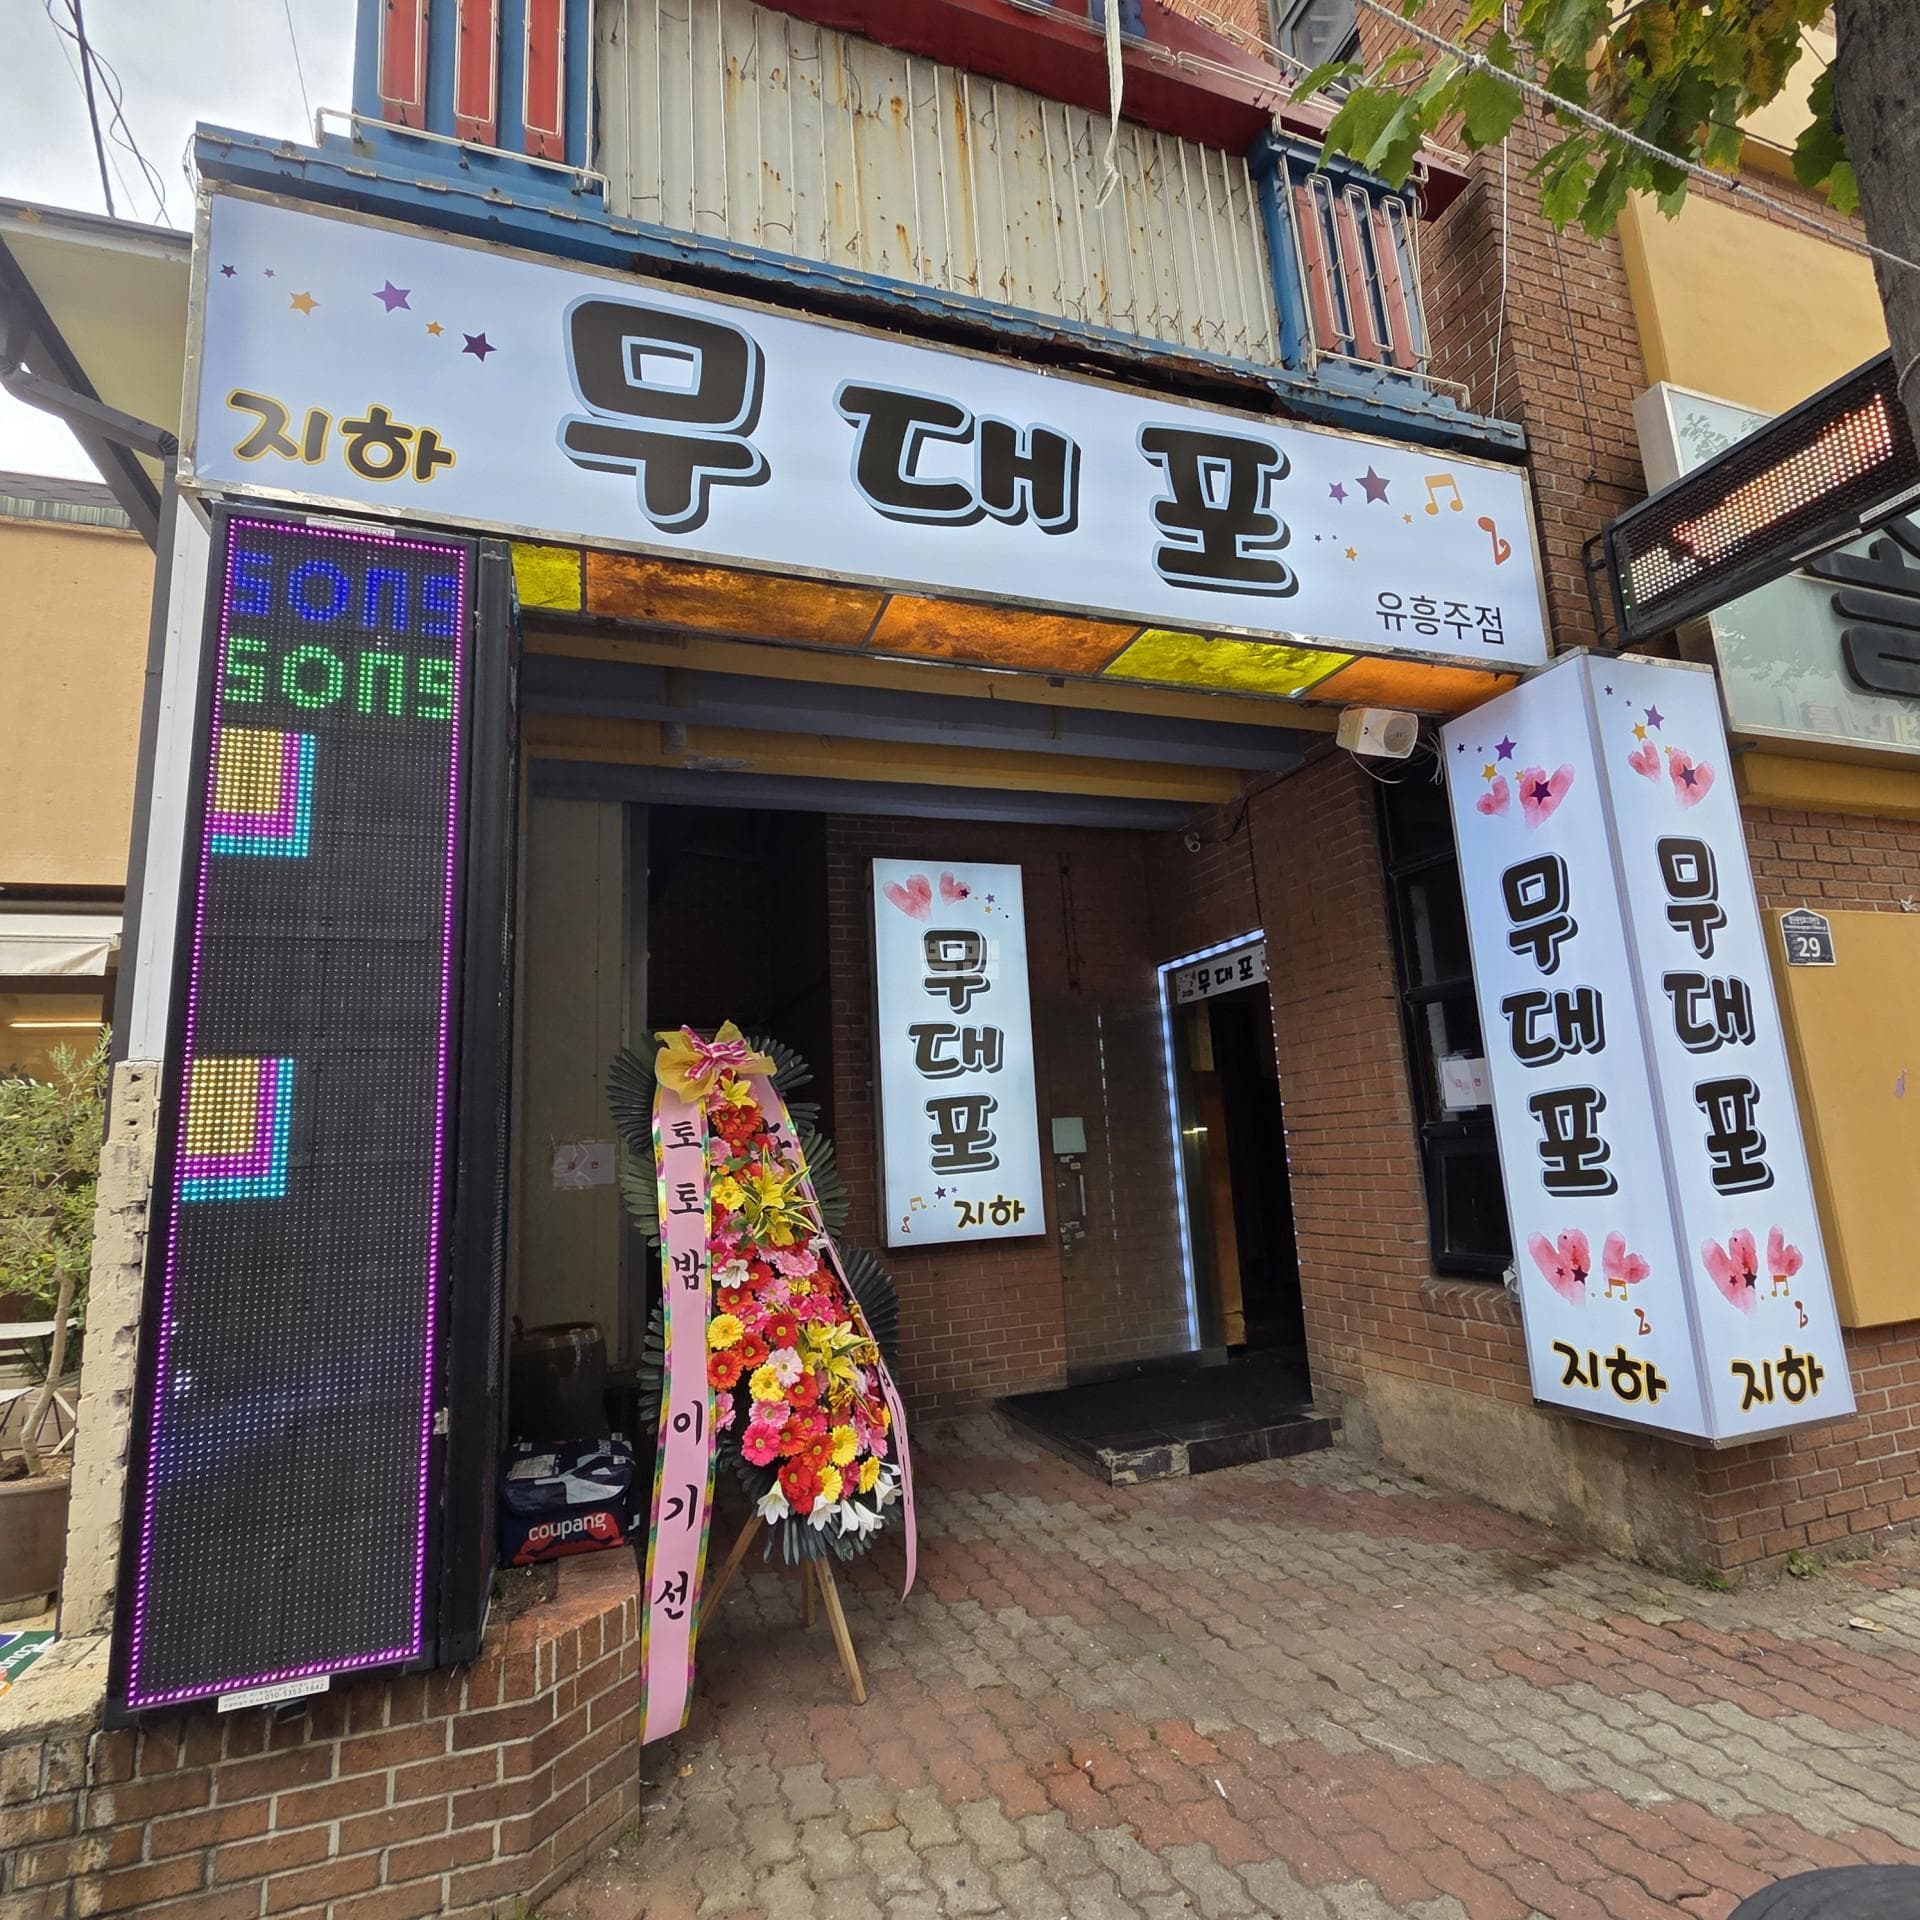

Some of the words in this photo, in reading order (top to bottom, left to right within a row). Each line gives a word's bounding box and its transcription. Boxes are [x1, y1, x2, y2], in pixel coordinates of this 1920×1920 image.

[226, 388, 456, 482] 지하
[1374, 590, 1505, 645] 유흥주점
[1797, 936, 1821, 958] 29
[666, 1121, 707, 1291] 토토밤
[953, 1194, 1025, 1229] 지하
[1552, 1338, 1670, 1404] 지하
[1729, 1344, 1826, 1411] 지하
[528, 1512, 608, 1541] coupang
[654, 1400, 703, 1620] 이기선
